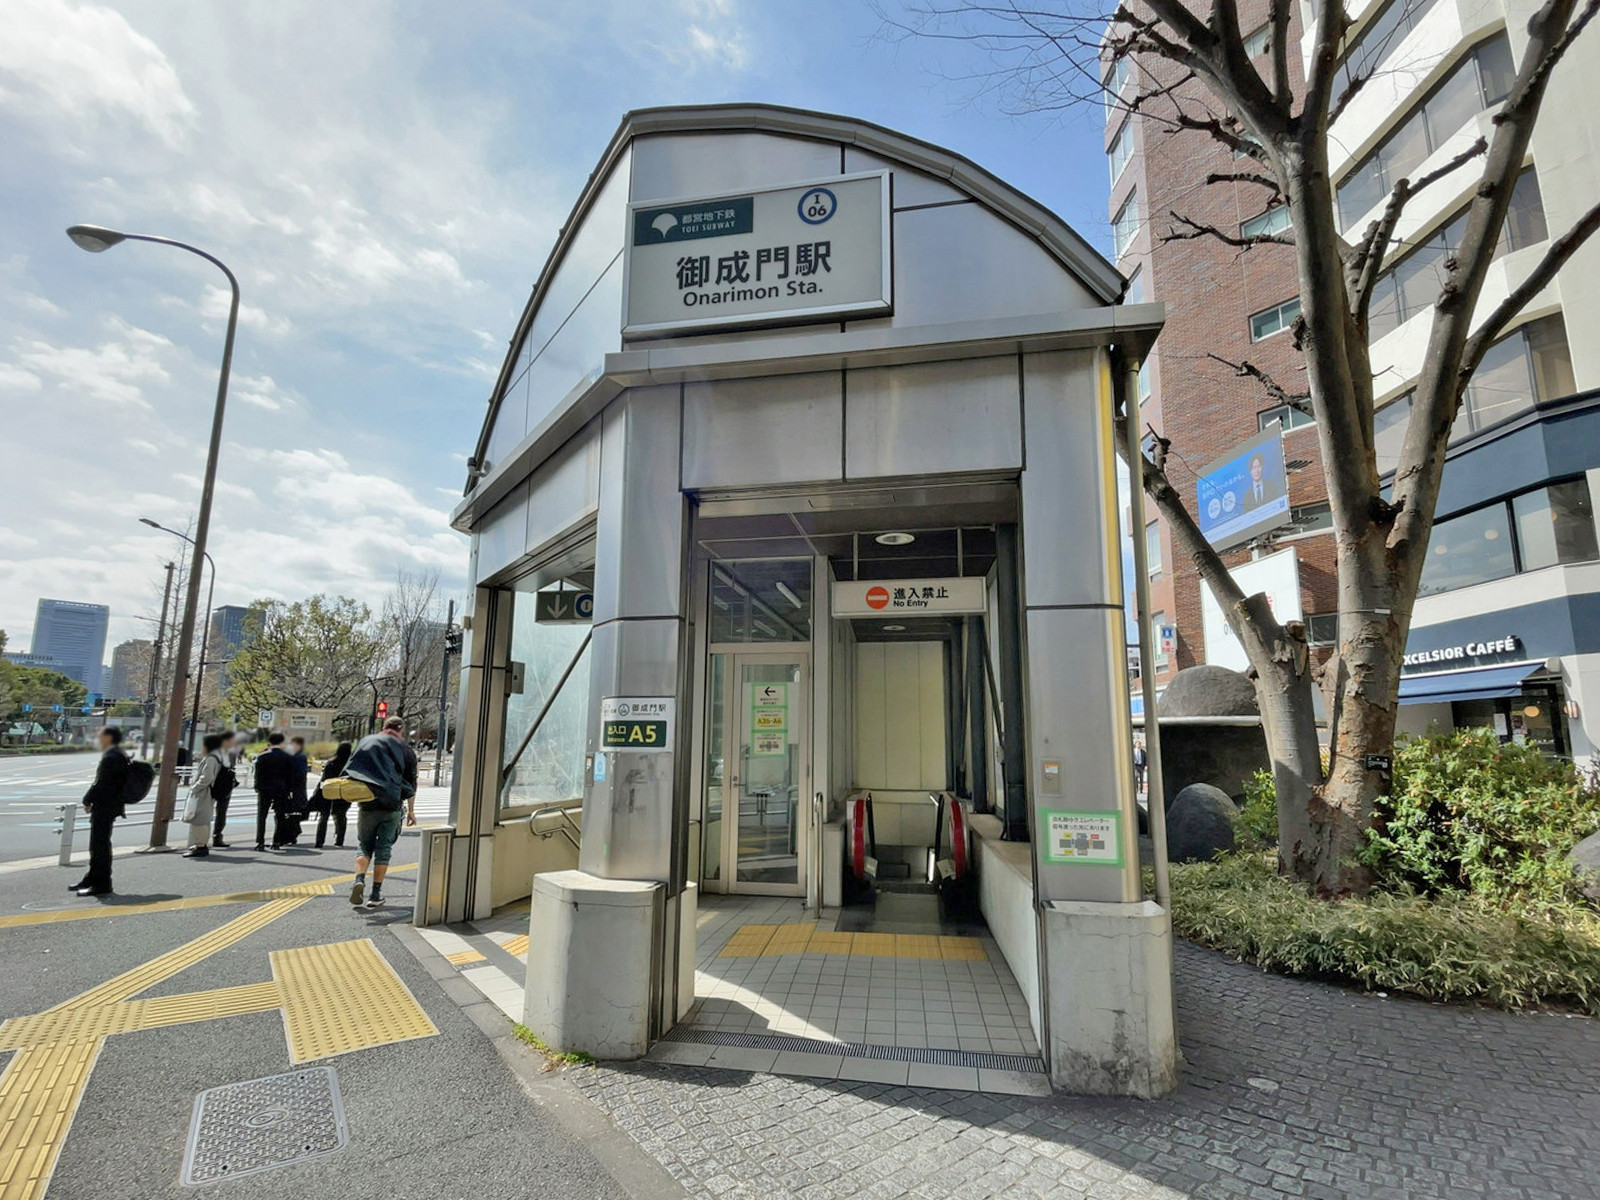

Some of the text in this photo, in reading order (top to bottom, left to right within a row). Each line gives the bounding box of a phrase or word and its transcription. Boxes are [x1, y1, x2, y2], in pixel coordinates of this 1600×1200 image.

[814, 194, 821, 205] I
[682, 209, 736, 225] 都営地下鉄
[808, 205, 827, 217] 06
[682, 220, 735, 233] TOEI SUBWAY
[676, 241, 832, 290] 御成門駅
[683, 280, 823, 307] Onarimon Sta.
[893, 586, 949, 600] 進入禁止
[1402, 635, 1515, 666] XCELSIOR CAFFÉ
[628, 724, 657, 743] A5
